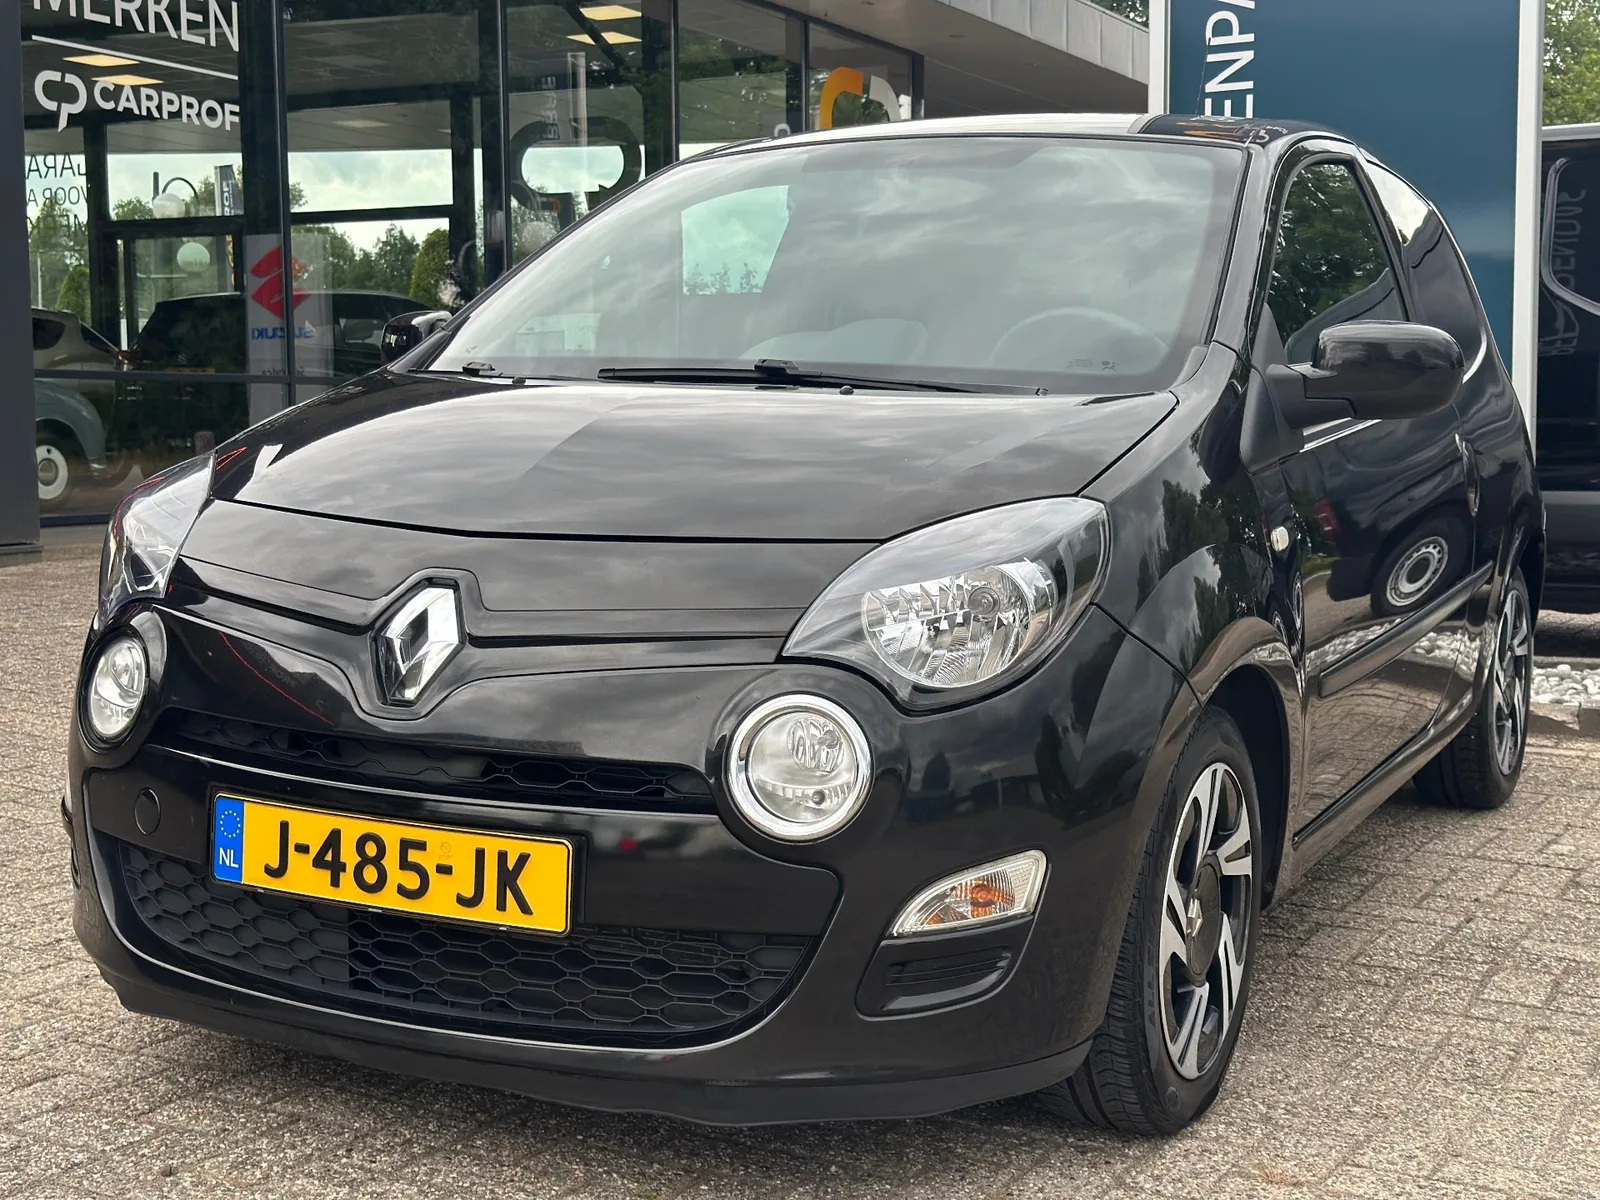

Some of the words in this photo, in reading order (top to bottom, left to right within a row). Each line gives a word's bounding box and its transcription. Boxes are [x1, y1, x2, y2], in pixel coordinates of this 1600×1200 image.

[93, 80, 241, 131] CARPROF
[1204, 0, 1256, 119] ENP
[219, 848, 239, 869] NL
[263, 819, 534, 917] J-485-JK
